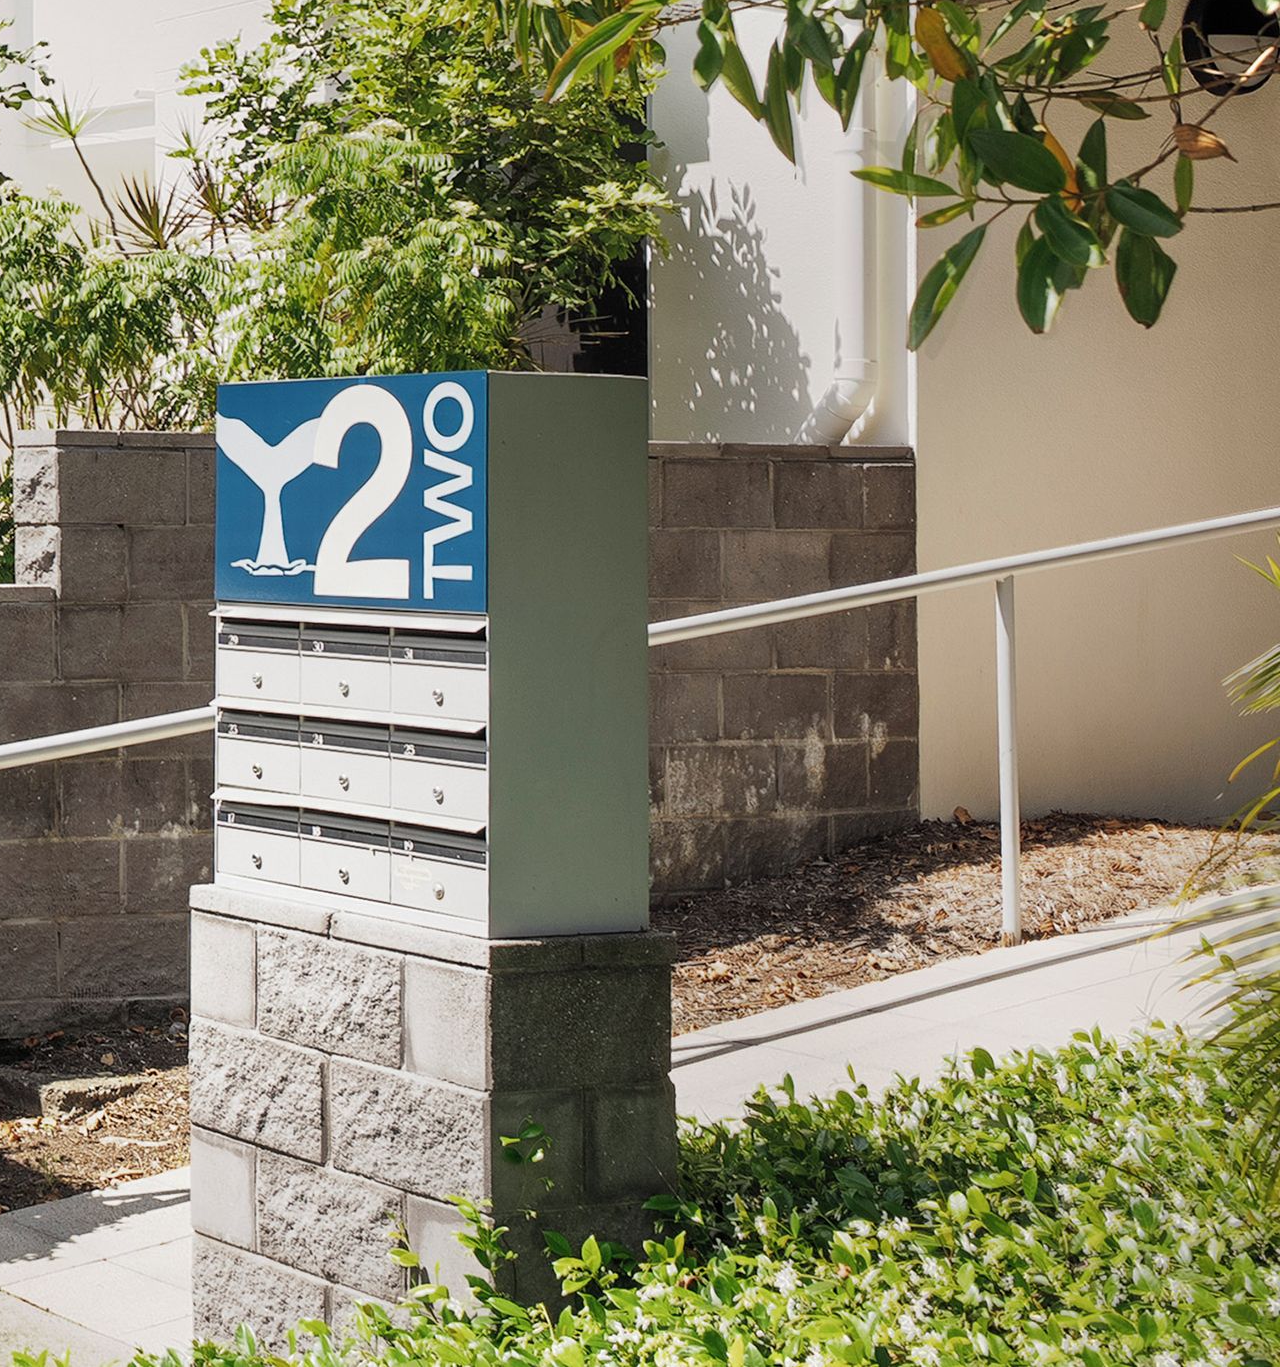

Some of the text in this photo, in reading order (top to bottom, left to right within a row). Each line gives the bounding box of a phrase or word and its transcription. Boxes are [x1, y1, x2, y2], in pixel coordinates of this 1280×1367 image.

[421, 380, 475, 601] TWO
[311, 640, 325, 653] 30
[403, 647, 414, 660] 31
